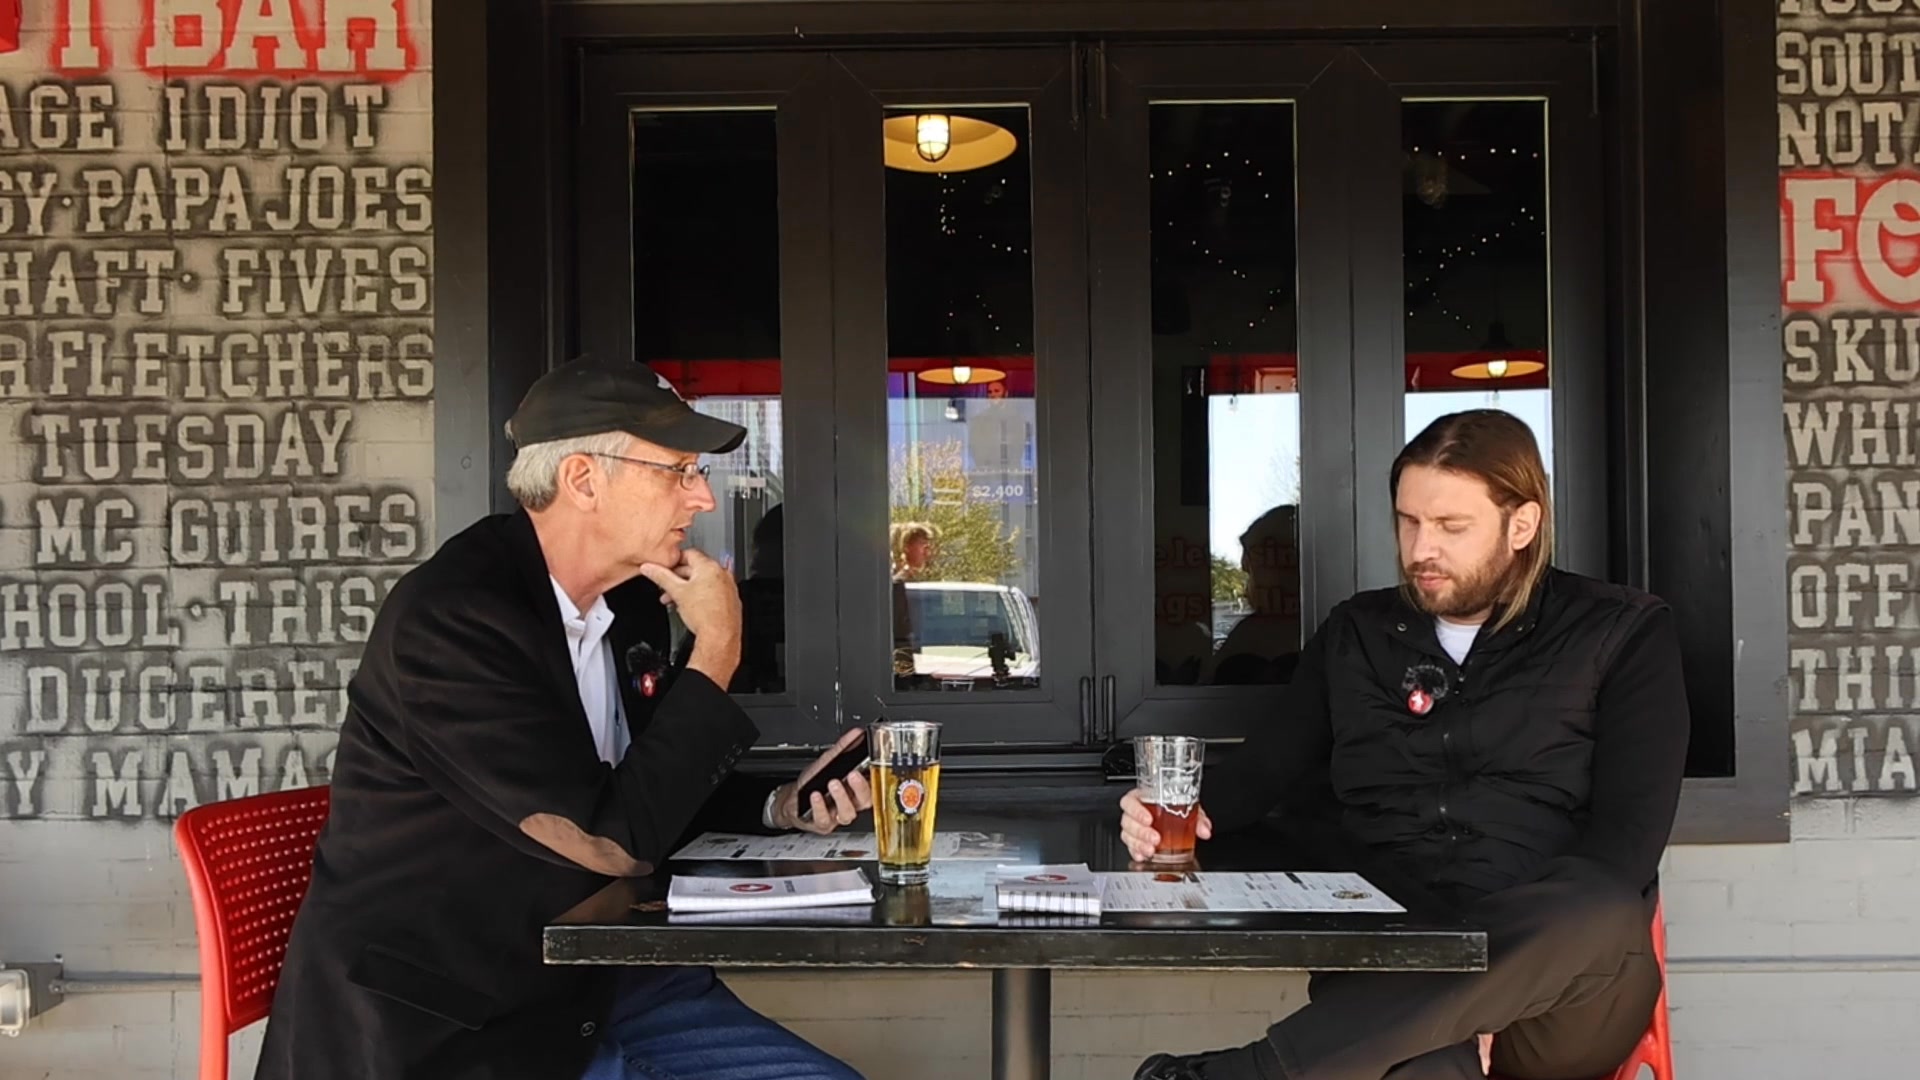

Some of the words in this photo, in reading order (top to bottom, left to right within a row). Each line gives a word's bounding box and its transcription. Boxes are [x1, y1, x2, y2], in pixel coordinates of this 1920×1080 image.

[165, 85, 383, 150] IDIOT
[1778, 102, 1920, 166] NOT
[83, 166, 252, 233] PAPA
[265, 166, 432, 233] JOES
[0, 249, 175, 315] HAFT
[222, 246, 428, 313] FIVES
[48, 331, 434, 399] FLETCHERS
[31, 409, 352, 480] TUESDAY
[1783, 400, 1920, 466] WHI
[972, 484, 1024, 498] $2,400
[1792, 480, 1920, 546] PAN
[37, 498, 135, 563] MC
[171, 494, 416, 565] GUIRES
[0, 582, 180, 648] HOOL
[1791, 563, 1908, 628] OFF
[1791, 645, 1920, 711] THI
[90, 747, 338, 816] MAMA
[1792, 727, 1916, 792] MIA
